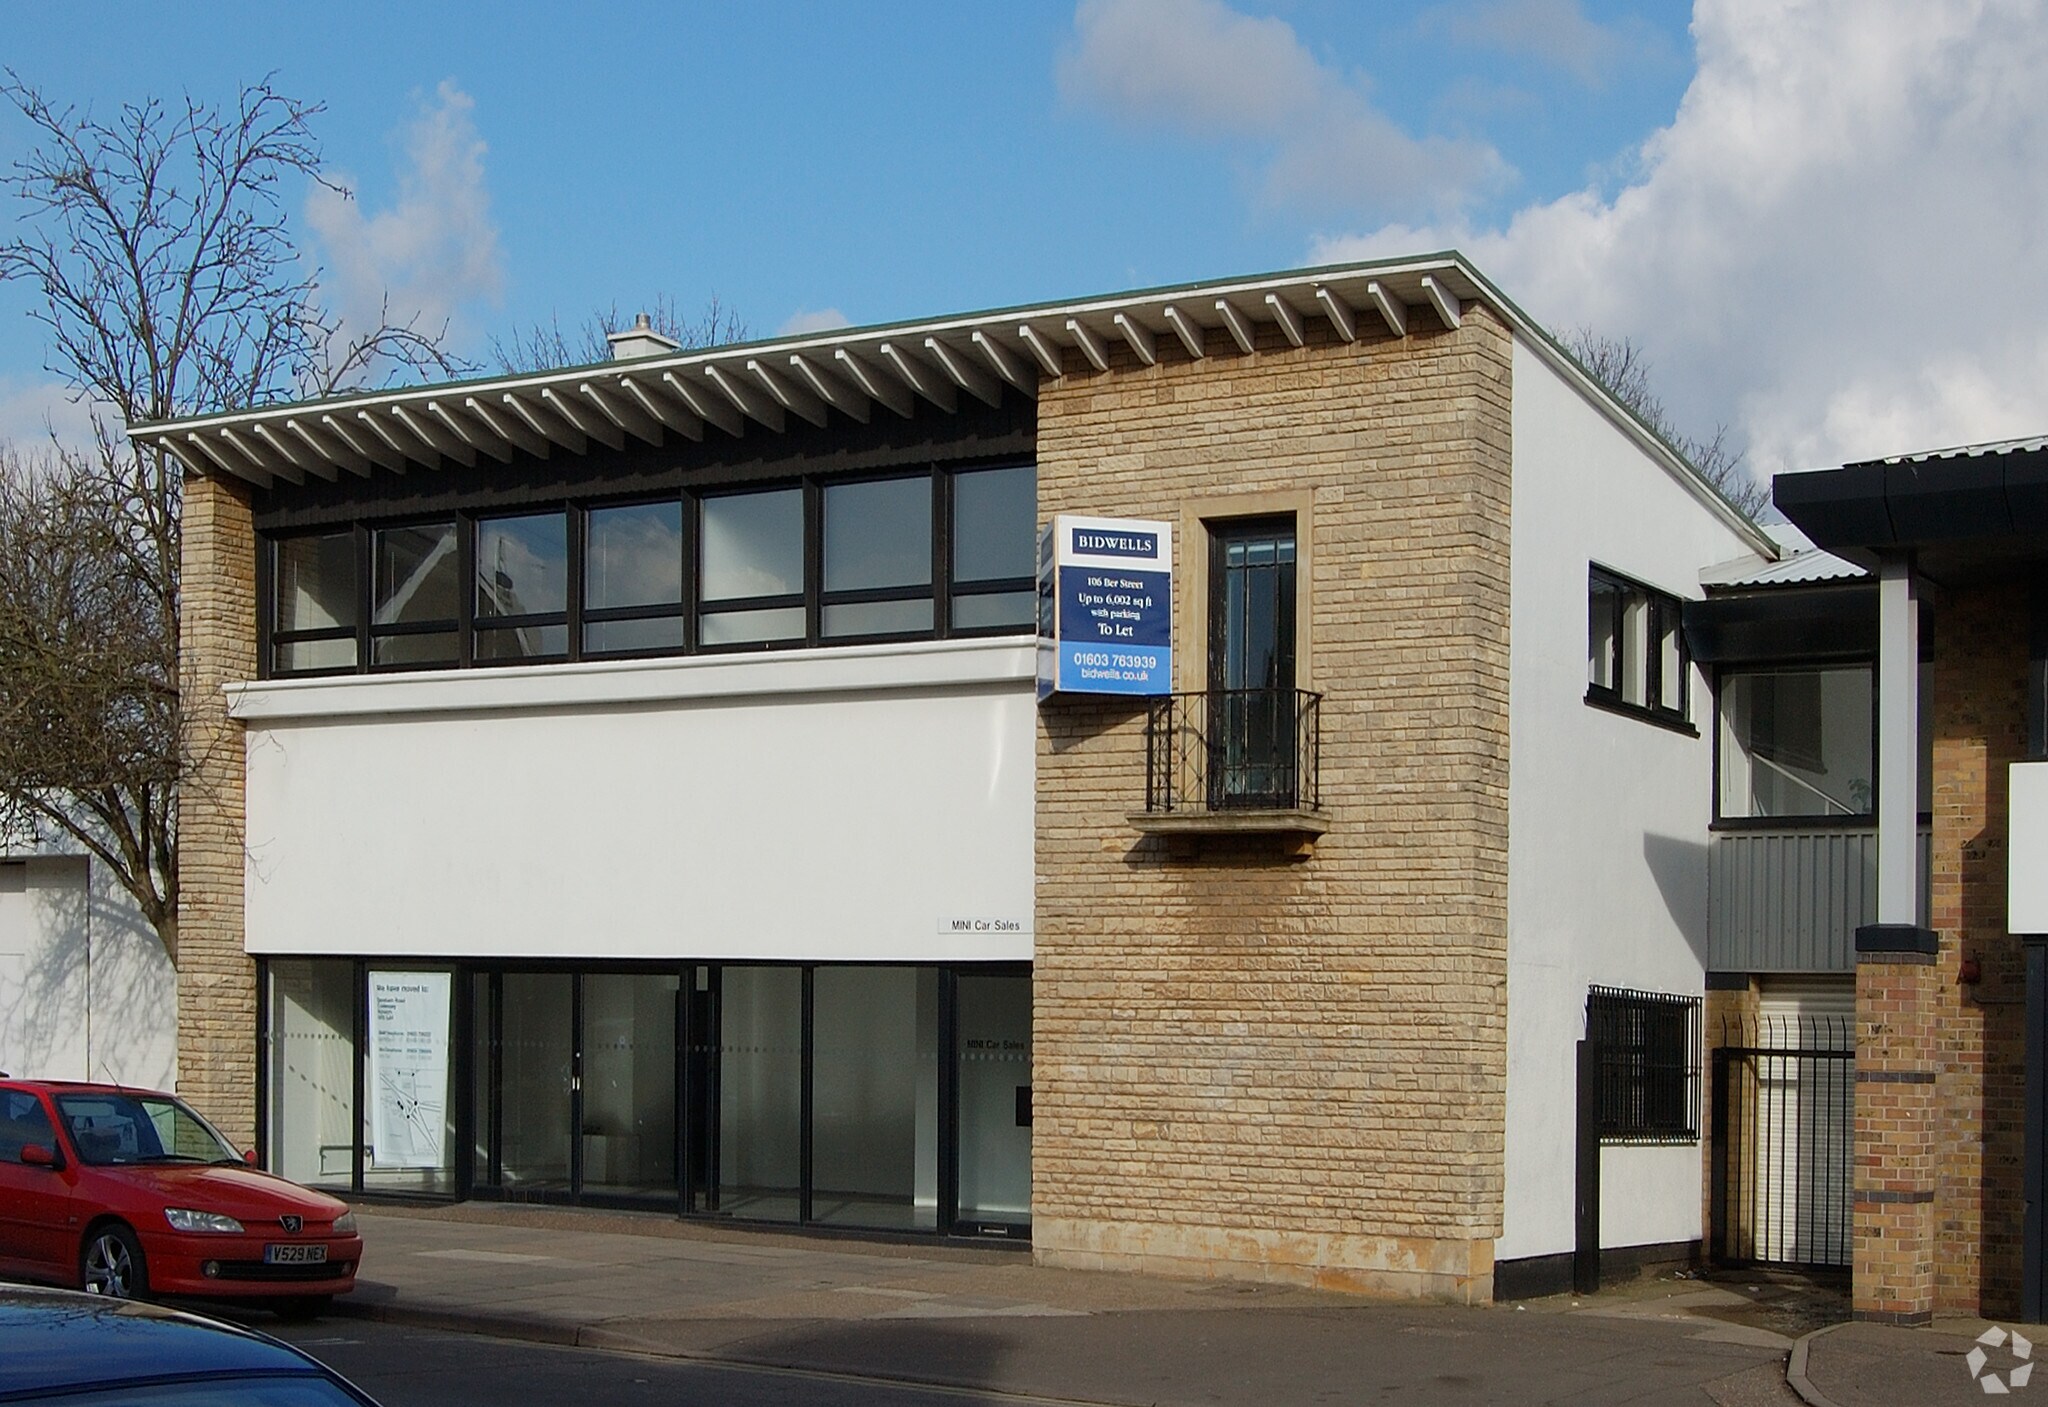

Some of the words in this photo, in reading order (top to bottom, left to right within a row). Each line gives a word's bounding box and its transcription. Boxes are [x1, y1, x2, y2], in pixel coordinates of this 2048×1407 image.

[1079, 535, 1152, 552] BIDWELLS
[1087, 577, 1103, 587] 106
[1104, 577, 1118, 588] Ber
[1120, 578, 1144, 590] Street
[1078, 592, 1092, 606] Up
[1093, 595, 1104, 604] to
[1132, 598, 1144, 609] sq
[1145, 596, 1152, 609] ft
[1091, 608, 1109, 618] with
[1110, 609, 1141, 621] parking
[1098, 622, 1113, 635] To
[1115, 623, 1134, 637] Let
[1073, 652, 1109, 667] 01603
[1112, 654, 1156, 669] 763939
[1081, 668, 1149, 681] bidwells.co.uk
[951, 920, 971, 930] MINI
[975, 920, 991, 931] Car
[994, 920, 1020, 931] Sales
[967, 1040, 984, 1049] MINI
[986, 1041, 1000, 1049] Car
[1003, 1041, 1025, 1050] Sales
[274, 1246, 305, 1261] V529
